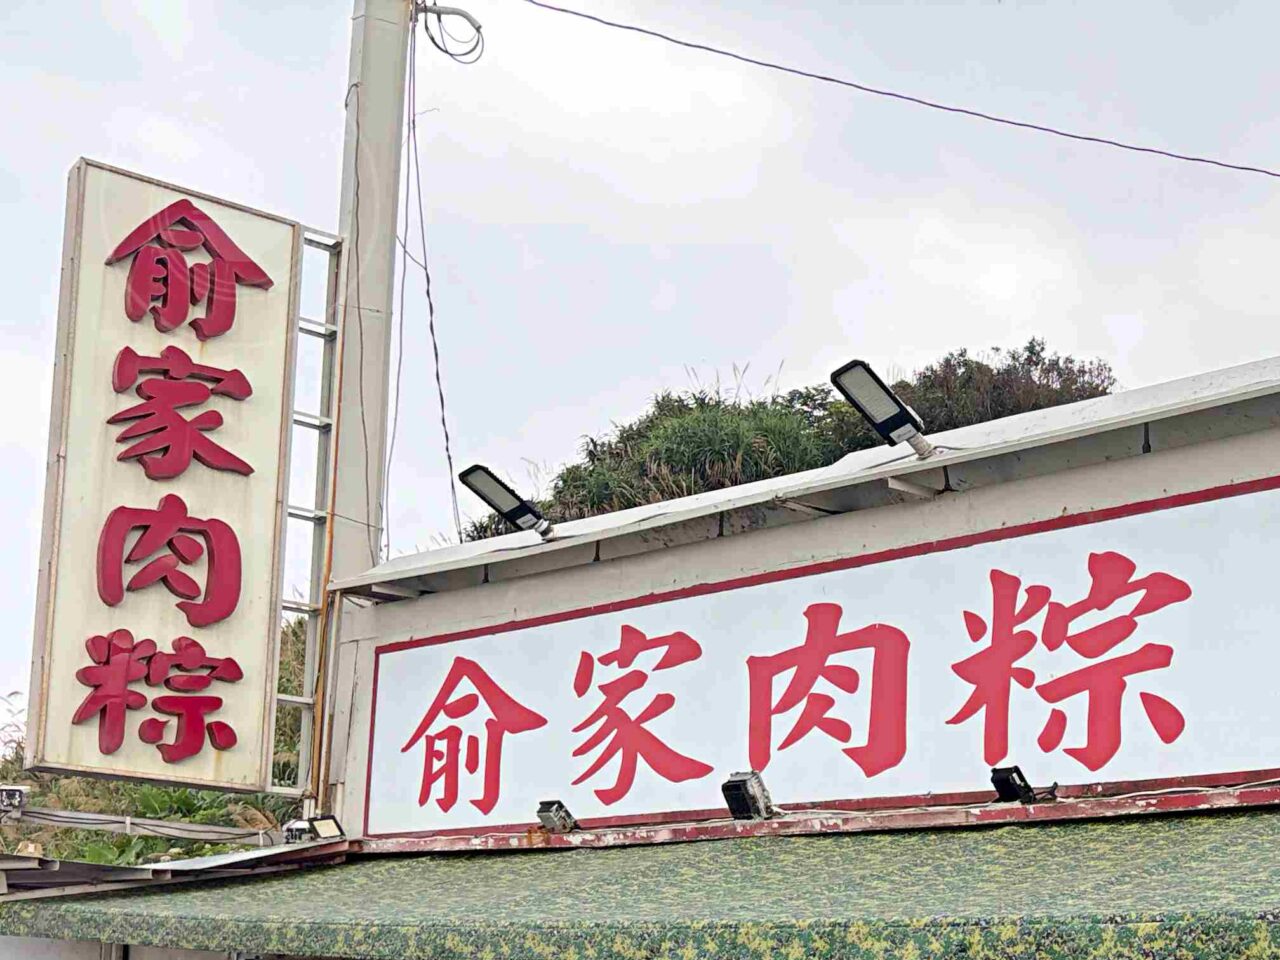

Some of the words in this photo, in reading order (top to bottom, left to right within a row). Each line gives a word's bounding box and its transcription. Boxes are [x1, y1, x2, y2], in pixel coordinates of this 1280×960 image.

[71, 198, 275, 764] 俞家肉粽
[400, 550, 1192, 815] 俞家肉粽
